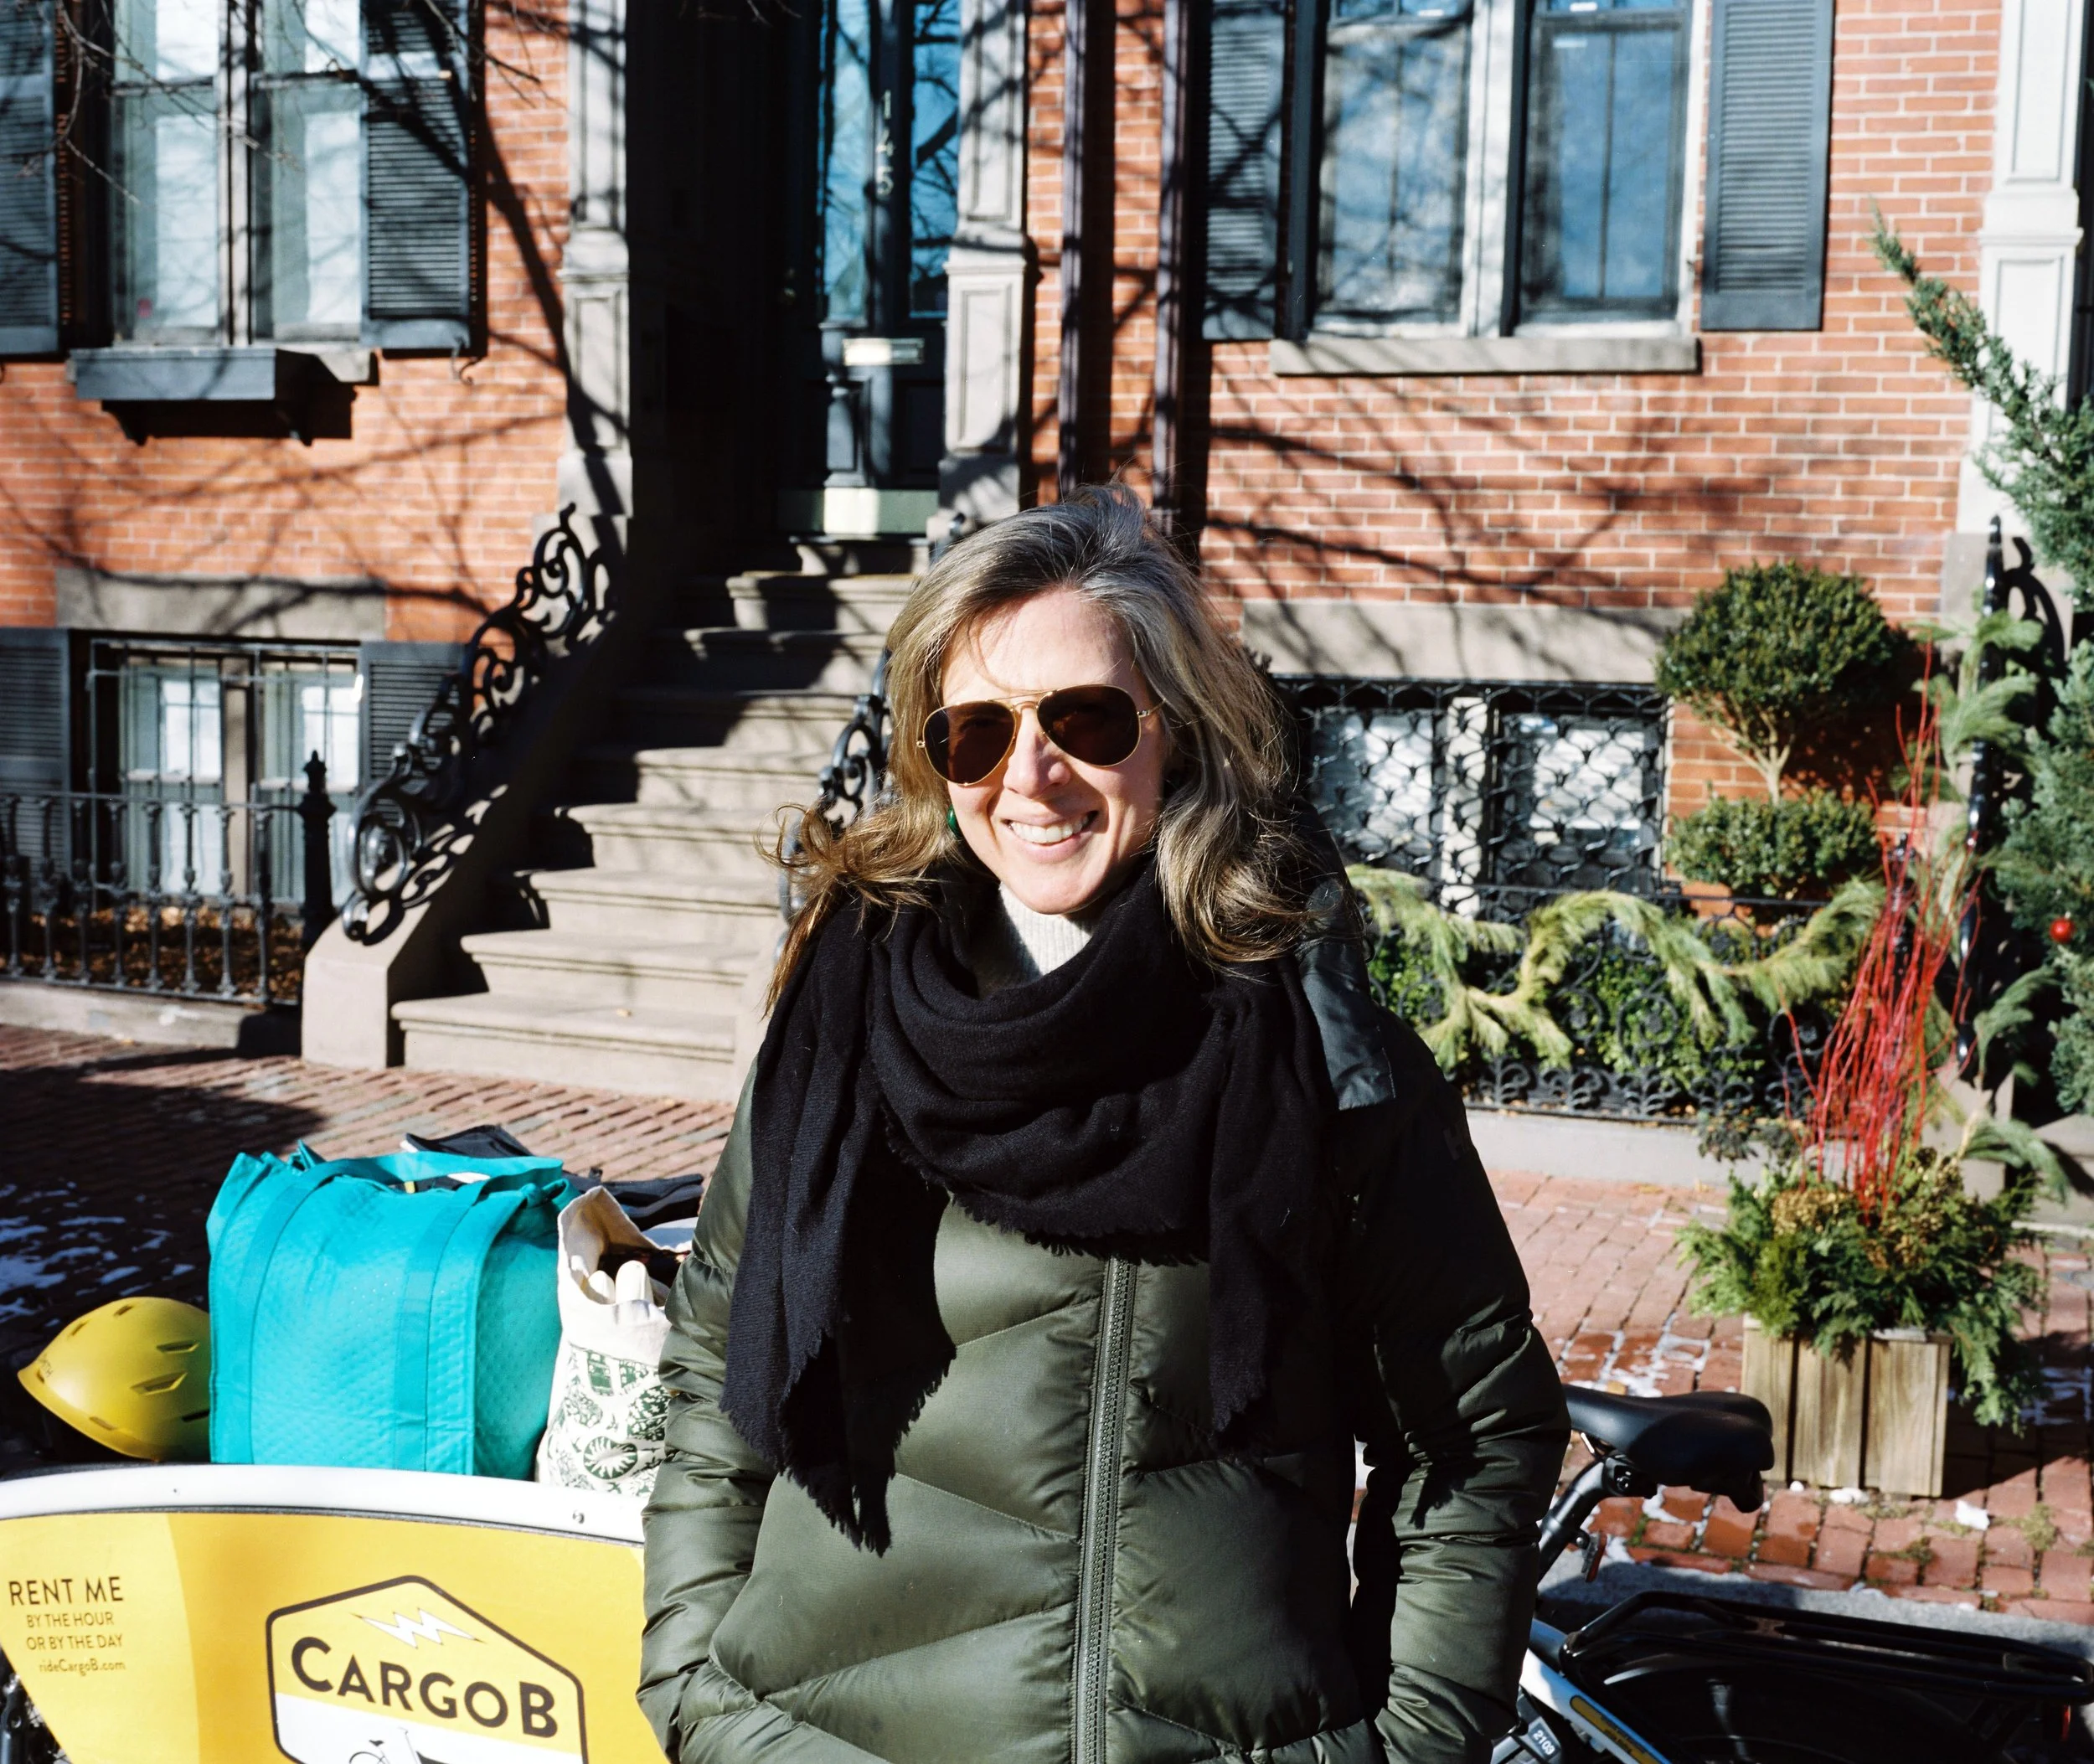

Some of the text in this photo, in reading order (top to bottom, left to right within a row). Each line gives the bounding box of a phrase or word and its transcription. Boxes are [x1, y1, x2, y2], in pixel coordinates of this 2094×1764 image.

[8, 1576, 124, 1606] RENT ME
[27, 1612, 114, 1627] BY THE HOUR
[26, 1633, 123, 1650] OR BY THE DAY
[39, 1658, 126, 1676] rideCargoB.com
[291, 1636, 558, 1738] CARGOB
[1533, 1730, 1555, 1756] 2103
